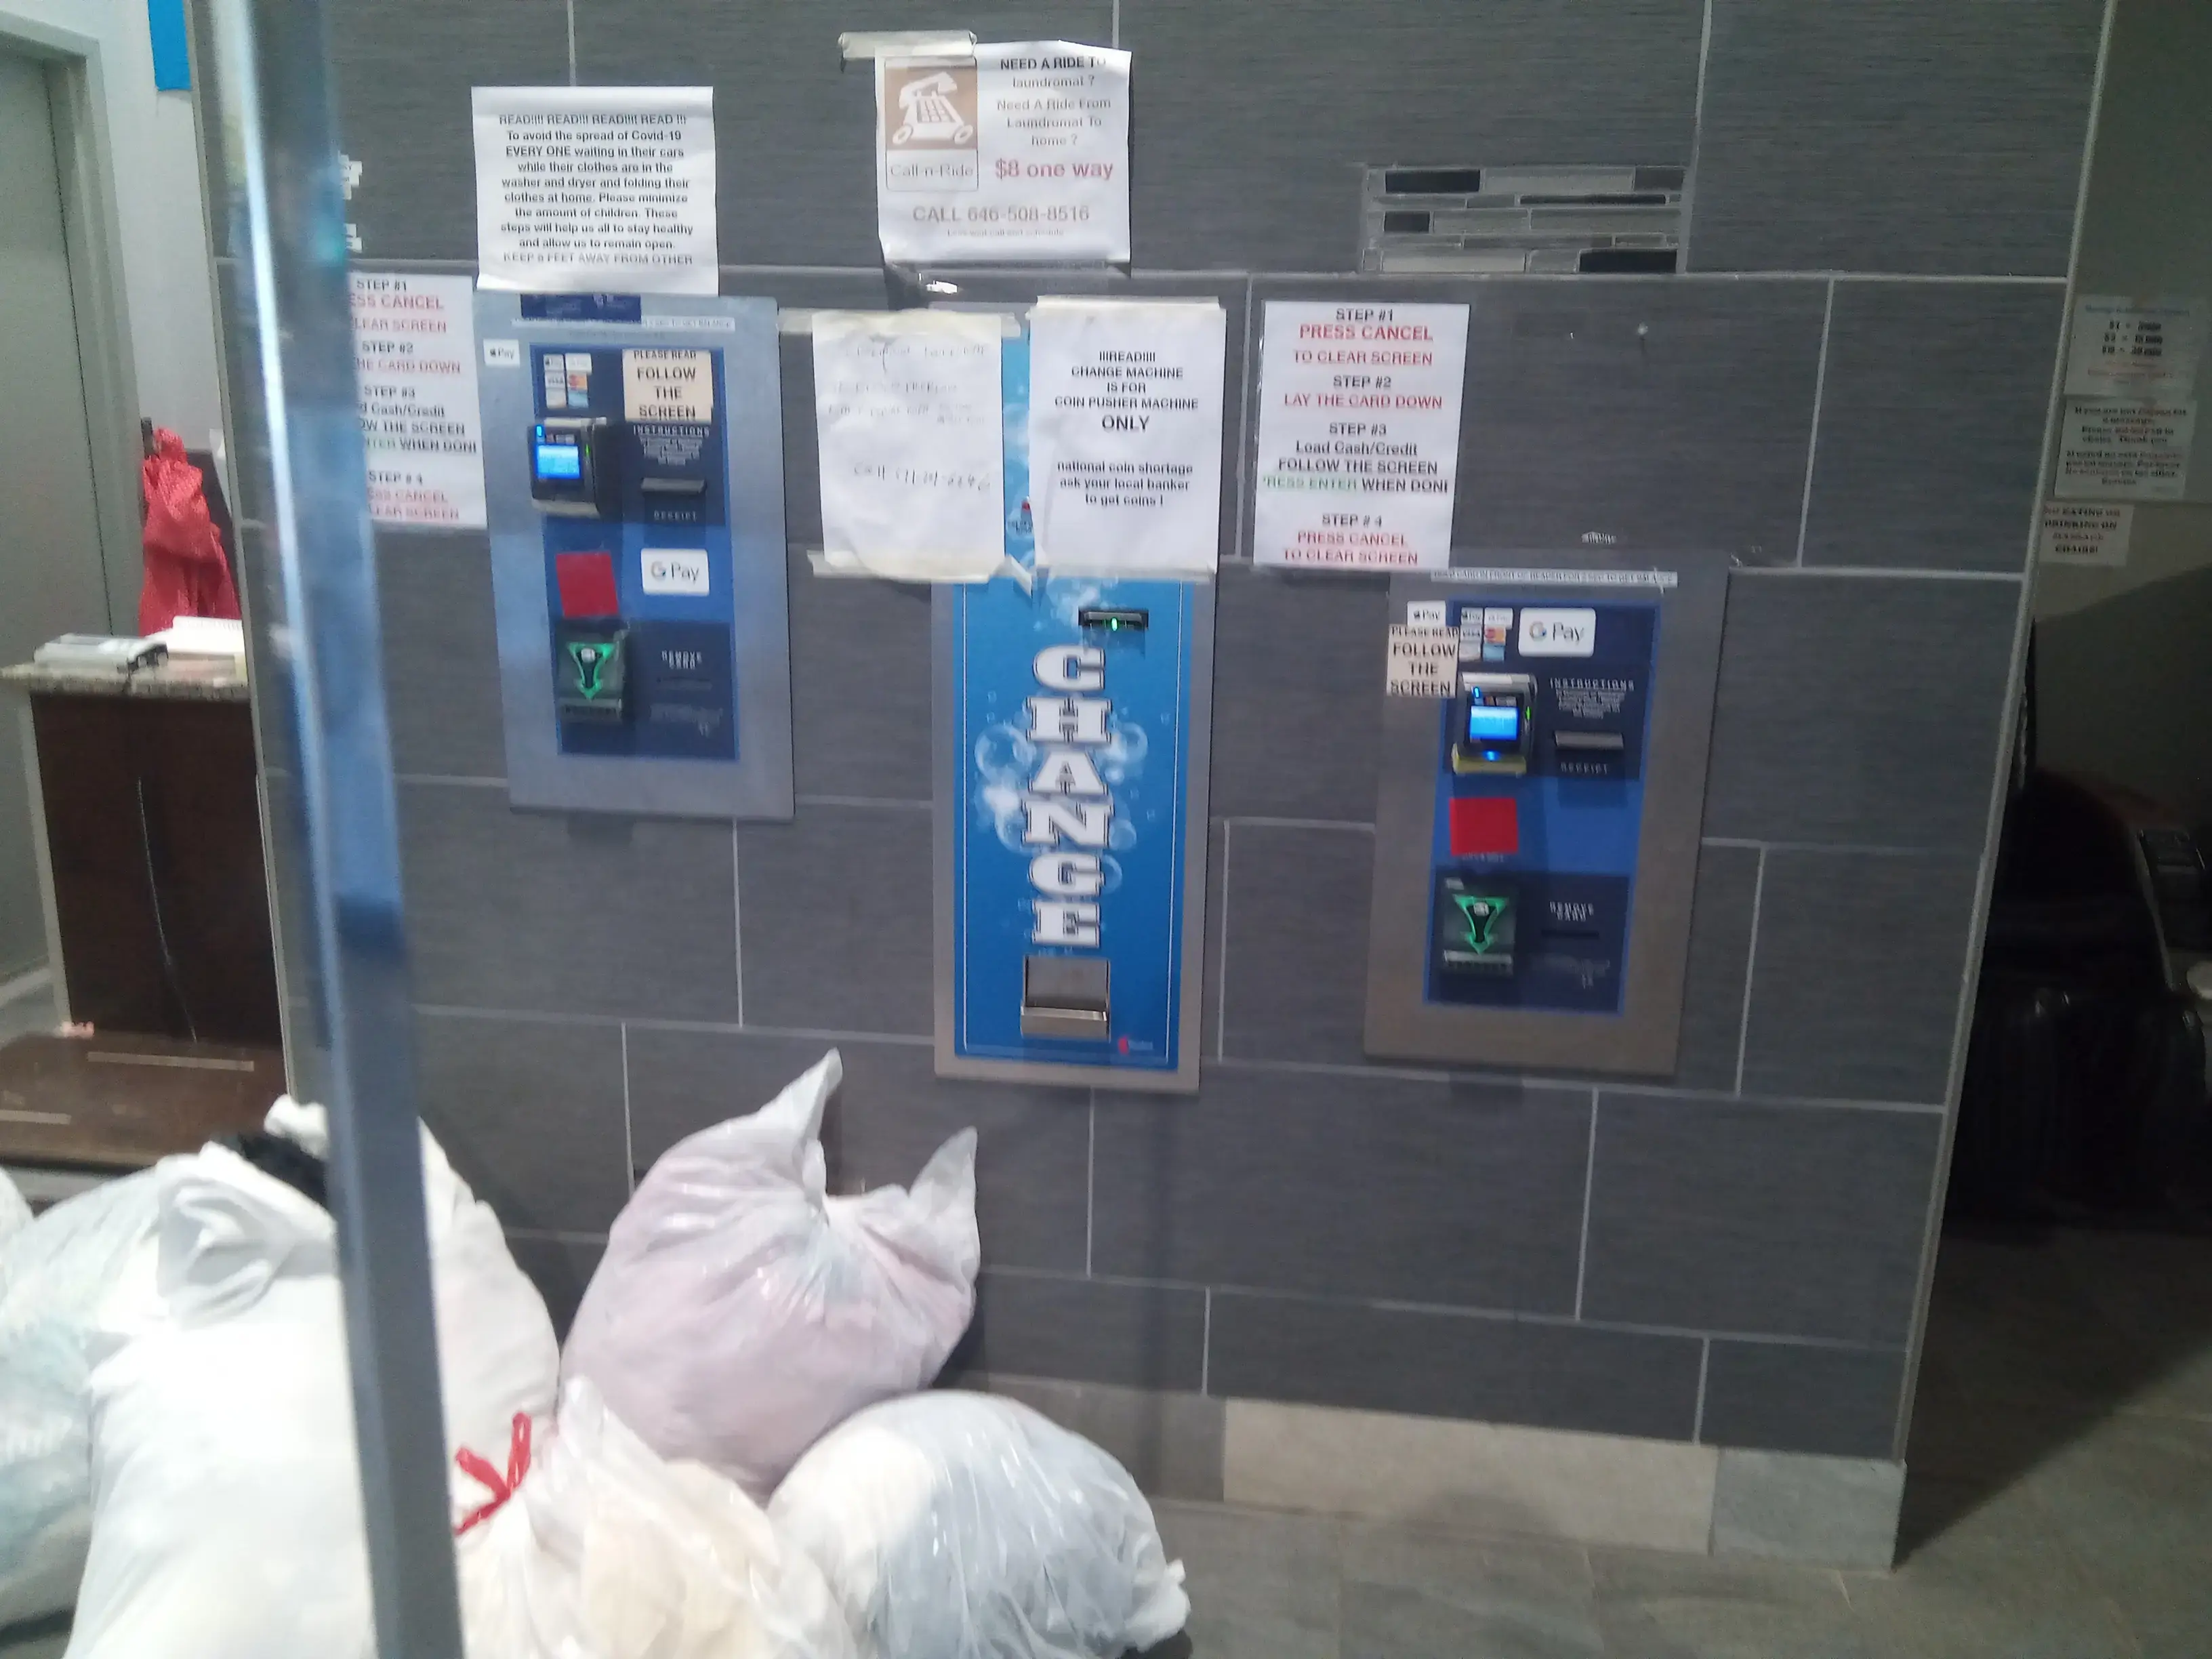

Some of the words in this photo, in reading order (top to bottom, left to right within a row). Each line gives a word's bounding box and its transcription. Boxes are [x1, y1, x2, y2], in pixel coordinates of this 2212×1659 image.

[1000, 58, 1037, 71] NEED
[1041, 58, 1050, 70] A
[1053, 57, 1084, 70] RIDE
[1012, 77, 1085, 89] laundromat
[997, 100, 1029, 111] Need
[1047, 99, 1075, 110] Ride
[508, 130, 519, 141] To
[523, 130, 552, 141] avoid
[556, 130, 572, 141] the
[576, 130, 614, 143] spread
[618, 130, 628, 141] of
[632, 130, 682, 141] Covid-19
[506, 146, 542, 157] EVERY
[546, 146, 571, 157] ONE
[575, 146, 614, 159] waiting
[618, 146, 628, 157] in
[632, 146, 655, 157] their
[660, 148, 684, 157] cars
[518, 162, 546, 172] while
[550, 162, 573, 172] their
[577, 162, 617, 173] clothes
[622, 164, 638, 173] are
[642, 163, 652, 172] in
[656, 162, 672, 173] the
[1027, 162, 1065, 178] one
[1073, 161, 1113, 181] way
[501, 177, 540, 188] washer
[545, 178, 565, 188] and
[568, 178, 596, 190] dryer
[600, 178, 620, 188] and
[624, 178, 661, 190] folding
[665, 178, 690, 188] their
[504, 192, 544, 203] clothes
[548, 194, 558, 203] at
[599, 194, 635, 203] Please
[638, 194, 688, 203] minimize
[515, 208, 532, 218] the
[536, 209, 577, 218] amount
[581, 209, 591, 218] of
[644, 209, 677, 218] These
[913, 206, 962, 222] CALL
[501, 224, 531, 234] steps
[534, 224, 552, 233] will
[555, 224, 578, 236] help
[581, 225, 594, 233] us
[598, 224, 609, 233] all
[613, 225, 623, 234] to
[628, 224, 649, 236] stay
[653, 224, 693, 236] healthy
[519, 239, 539, 247] and
[543, 239, 571, 248] allow
[590, 239, 600, 249] to
[604, 240, 641, 249] remain
[356, 279, 389, 291] STEP
[381, 294, 444, 310] CANCEL
[1336, 308, 1374, 322] STEP
[1378, 309, 1394, 322] #1
[1299, 324, 1356, 340] PRESS
[1361, 325, 1433, 341] CANCEL
[362, 340, 394, 353] STEP
[1294, 349, 1312, 363] TO
[1317, 350, 1366, 365] CLEAR
[1371, 350, 1433, 366] SCREEN
[419, 361, 460, 374] DOWN
[637, 367, 696, 382] FOLLOW
[1071, 367, 1123, 378] CHANGE
[1126, 367, 1184, 380] MACHINE
[1122, 382, 1147, 394] FOR
[1333, 375, 1370, 389] STEP
[1375, 376, 1391, 389] #2
[365, 386, 397, 398] STEP
[655, 386, 682, 400] THE
[1054, 397, 1085, 407] COIN
[1142, 398, 1199, 410] MACHINE
[1284, 393, 1311, 406] LAY
[1317, 393, 1345, 407] THE
[1349, 394, 1391, 409] CARD
[1395, 395, 1442, 409] DOWN
[639, 405, 696, 422] SCREEN
[1101, 415, 1150, 432] ONLY
[1329, 422, 1366, 436] STEP
[1371, 423, 1387, 436] #3
[400, 438, 439, 451] WHEN
[1296, 440, 1330, 454] Load
[1334, 441, 1418, 457] Cash/Credit
[1057, 460, 1105, 473] national
[1278, 457, 1340, 472] FOLLOW
[1345, 459, 1373, 473] THE
[1377, 460, 1438, 476] SCREEN
[1147, 478, 1190, 491] banker
[1361, 478, 1406, 493] WHEN
[1085, 494, 1097, 505] to
[1322, 513, 1358, 527] STEP
[1297, 531, 1345, 544] PRESS
[670, 562, 700, 583] Pay
[1552, 622, 1585, 645] Pay
[1392, 643, 1456, 658] FOLLOW
[1408, 661, 1438, 676] THE
[1390, 680, 1451, 697] SCREEN
[1020, 643, 1113, 949] CHANGE
